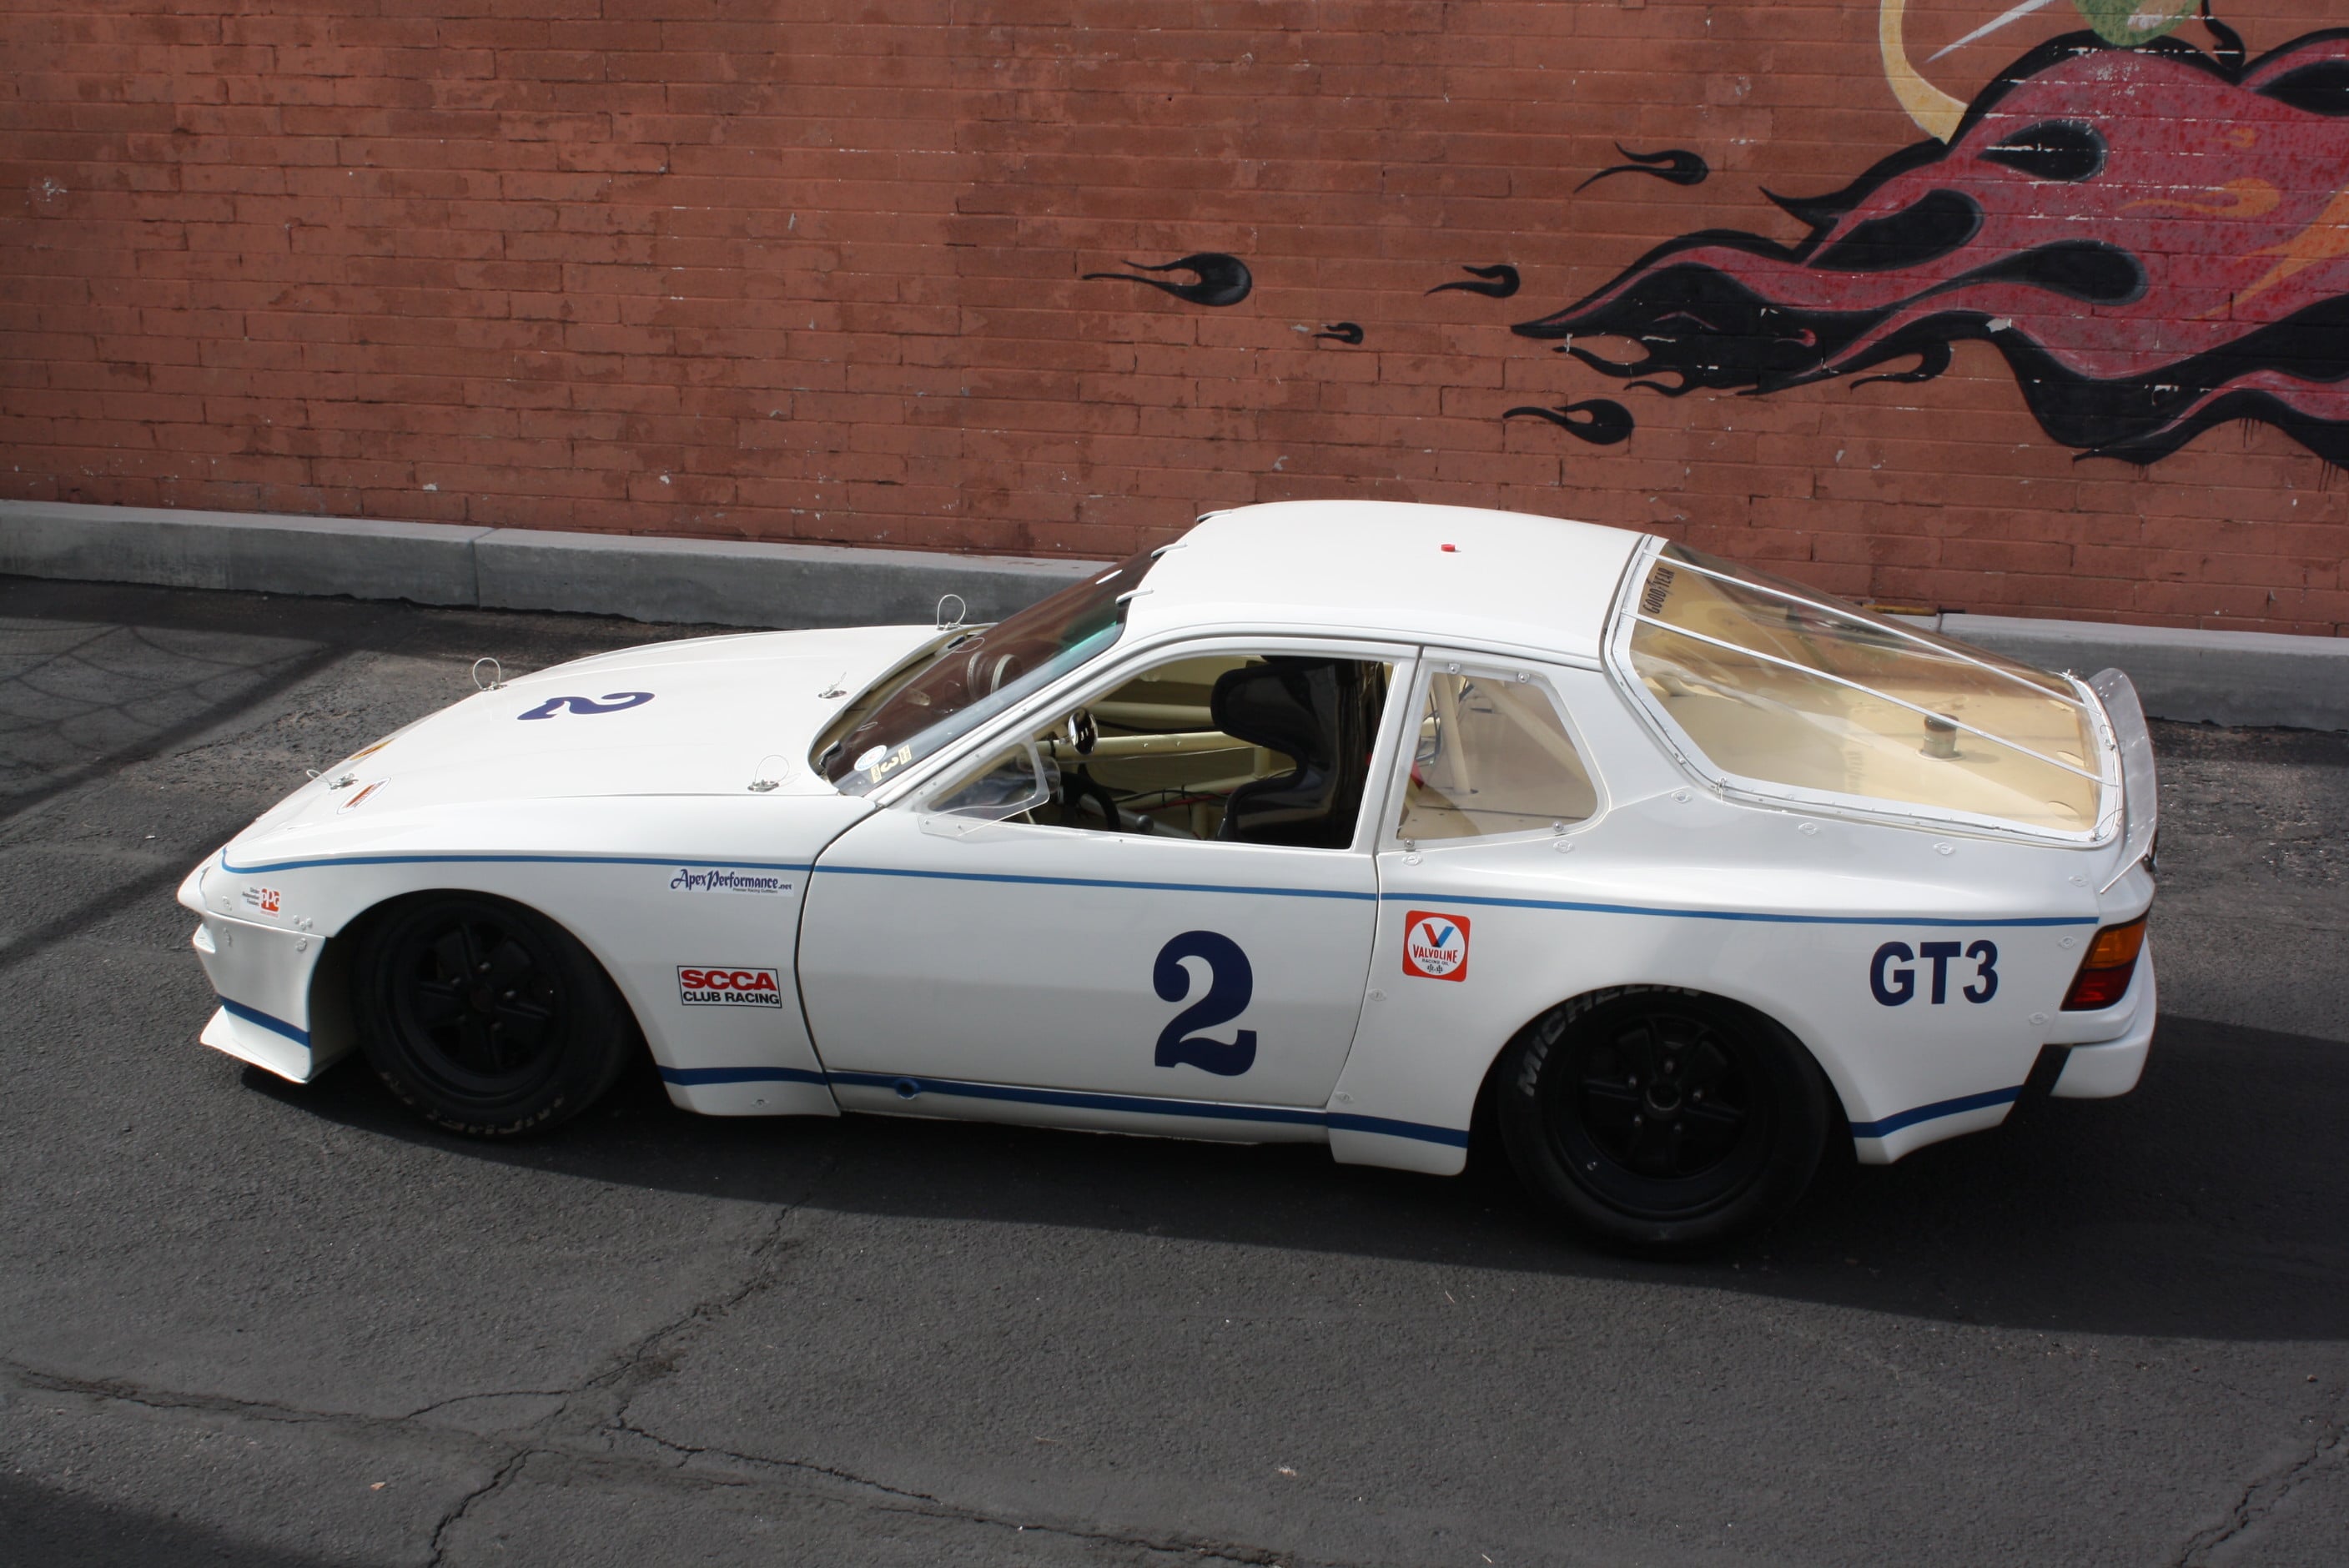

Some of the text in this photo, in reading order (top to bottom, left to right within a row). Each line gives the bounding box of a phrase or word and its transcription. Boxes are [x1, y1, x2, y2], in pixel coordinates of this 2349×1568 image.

[1642, 567, 1676, 615] GOODYEAR
[516, 691, 656, 721] 2
[1412, 943, 1458, 964] VALVOLINE
[681, 969, 777, 991] SCCA
[1869, 940, 1999, 1007] GT3
[682, 991, 780, 1004] CLUB RACING
[1153, 930, 1257, 1076] 2
